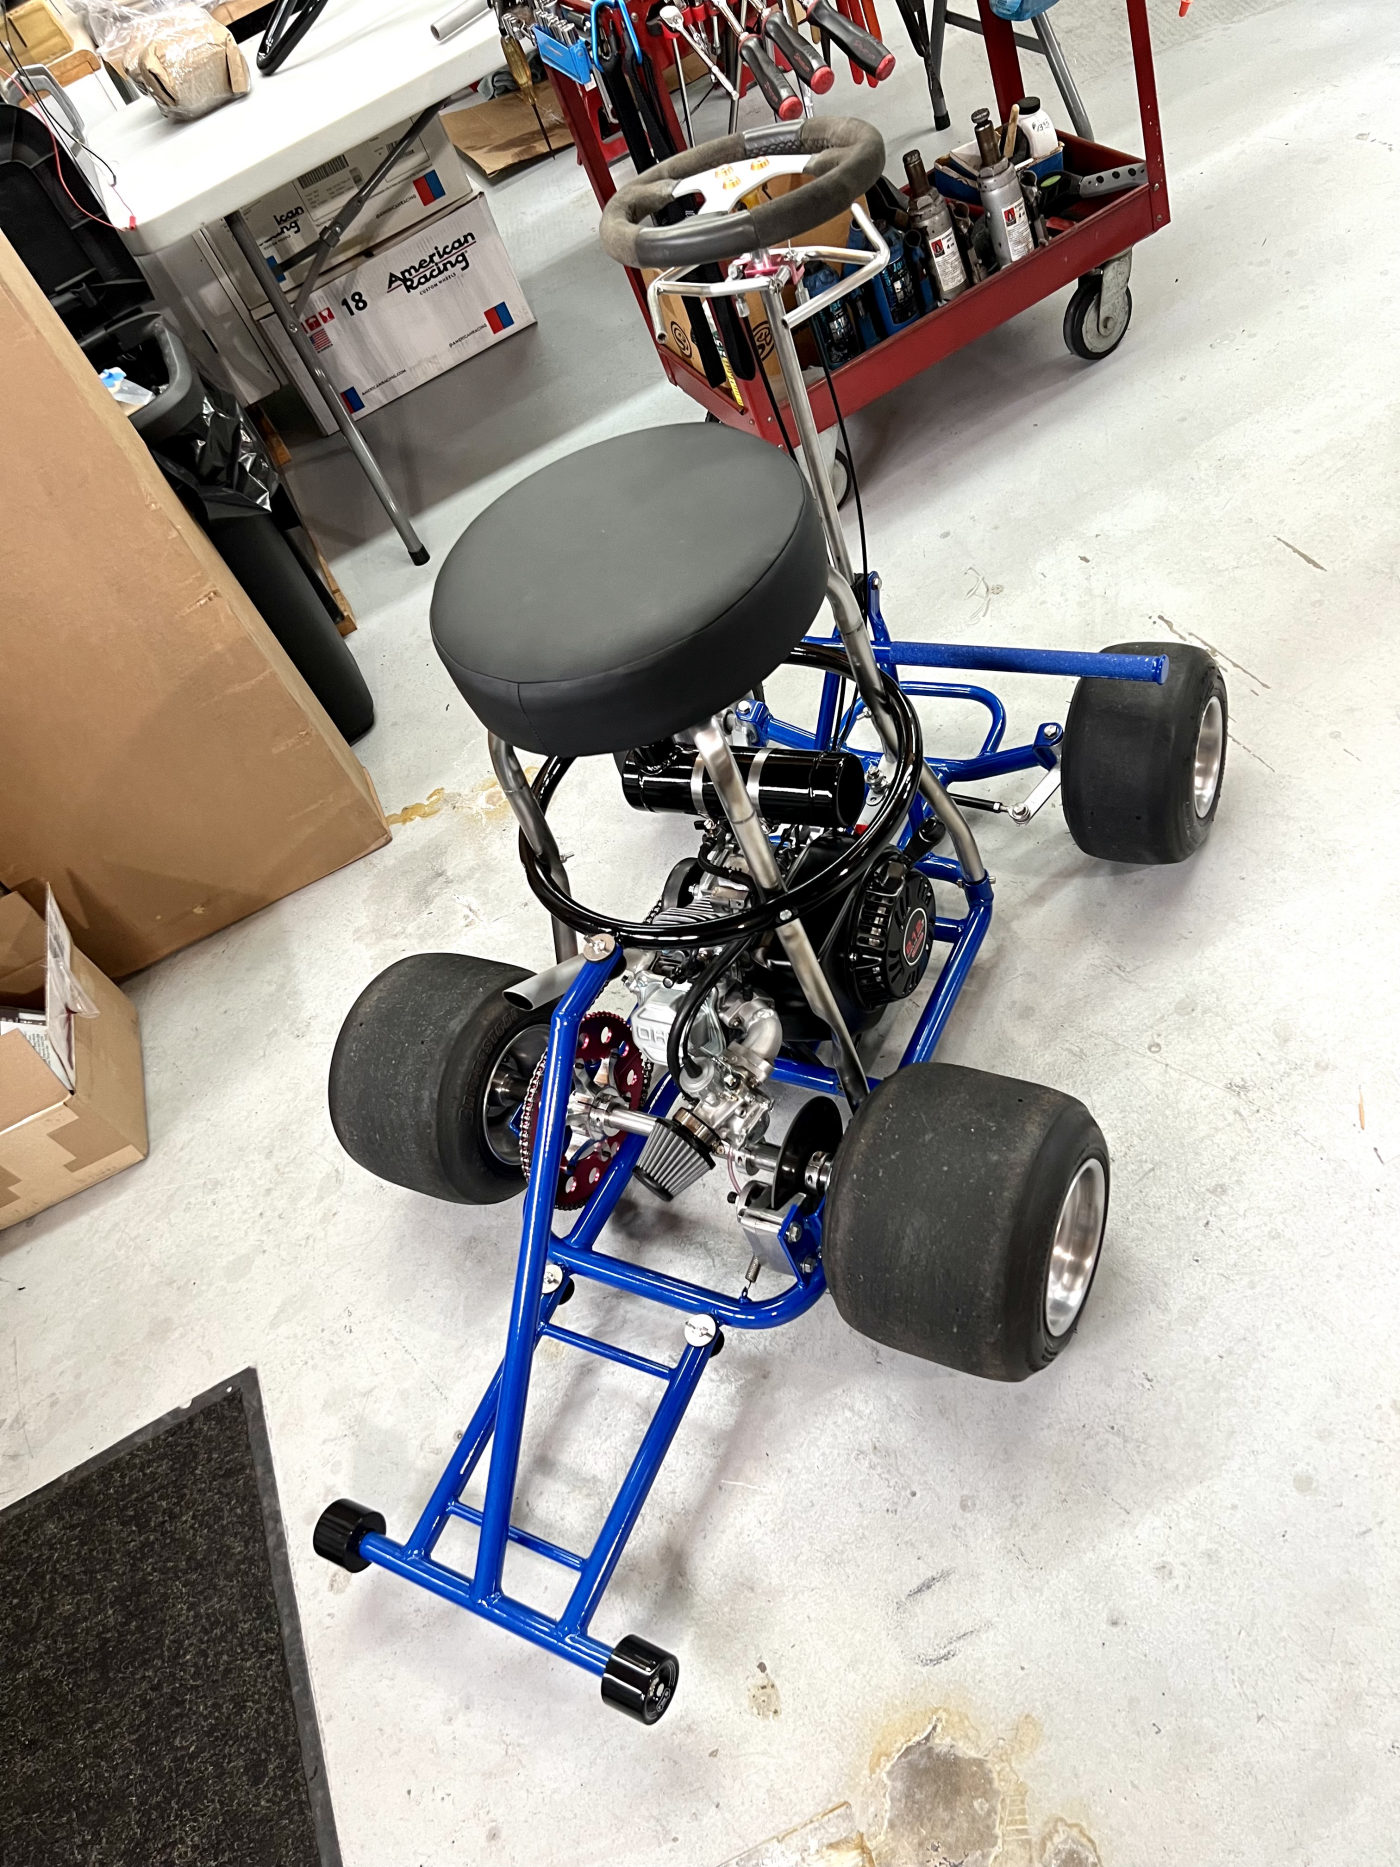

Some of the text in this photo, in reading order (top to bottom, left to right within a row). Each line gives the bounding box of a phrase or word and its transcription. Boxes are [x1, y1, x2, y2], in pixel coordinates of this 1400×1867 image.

[387, 232, 476, 290] American
[402, 251, 470, 294] Racing
[419, 272, 457, 295] CUSTOM WHEELS
[341, 291, 368, 316] 18
